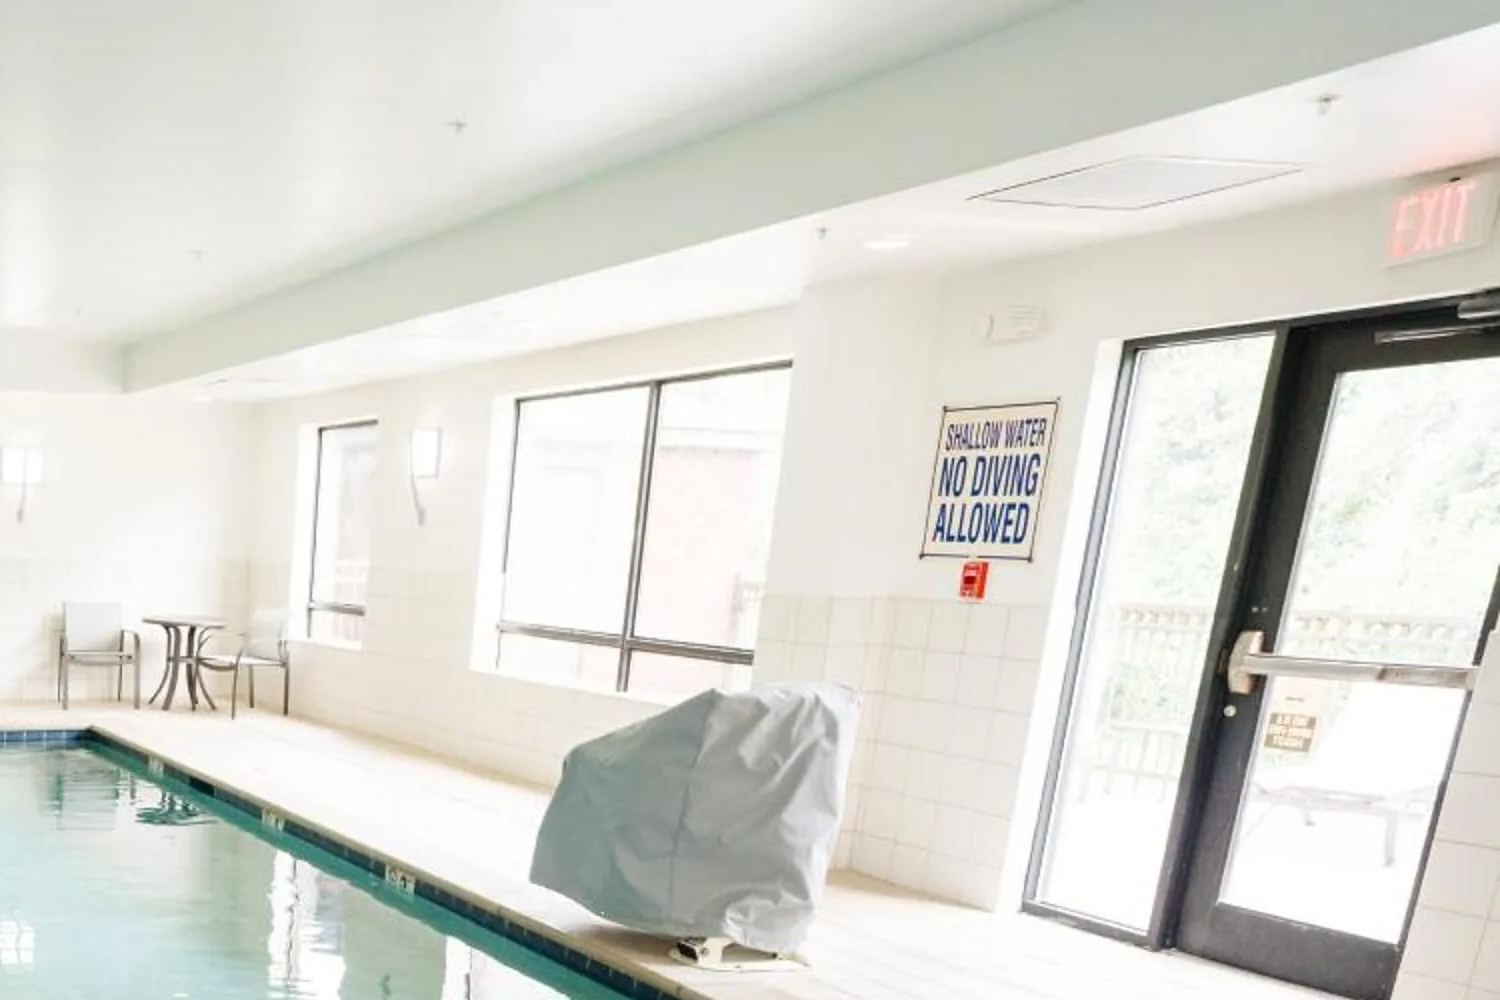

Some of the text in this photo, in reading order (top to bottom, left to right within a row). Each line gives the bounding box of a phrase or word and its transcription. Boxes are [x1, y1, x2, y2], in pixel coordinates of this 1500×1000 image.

[1393, 184, 1476, 257] EXIT
[945, 417, 1047, 451] SHALLOW WATER
[938, 453, 1041, 497] NO DIVING
[931, 502, 1031, 544] ALLOWED
